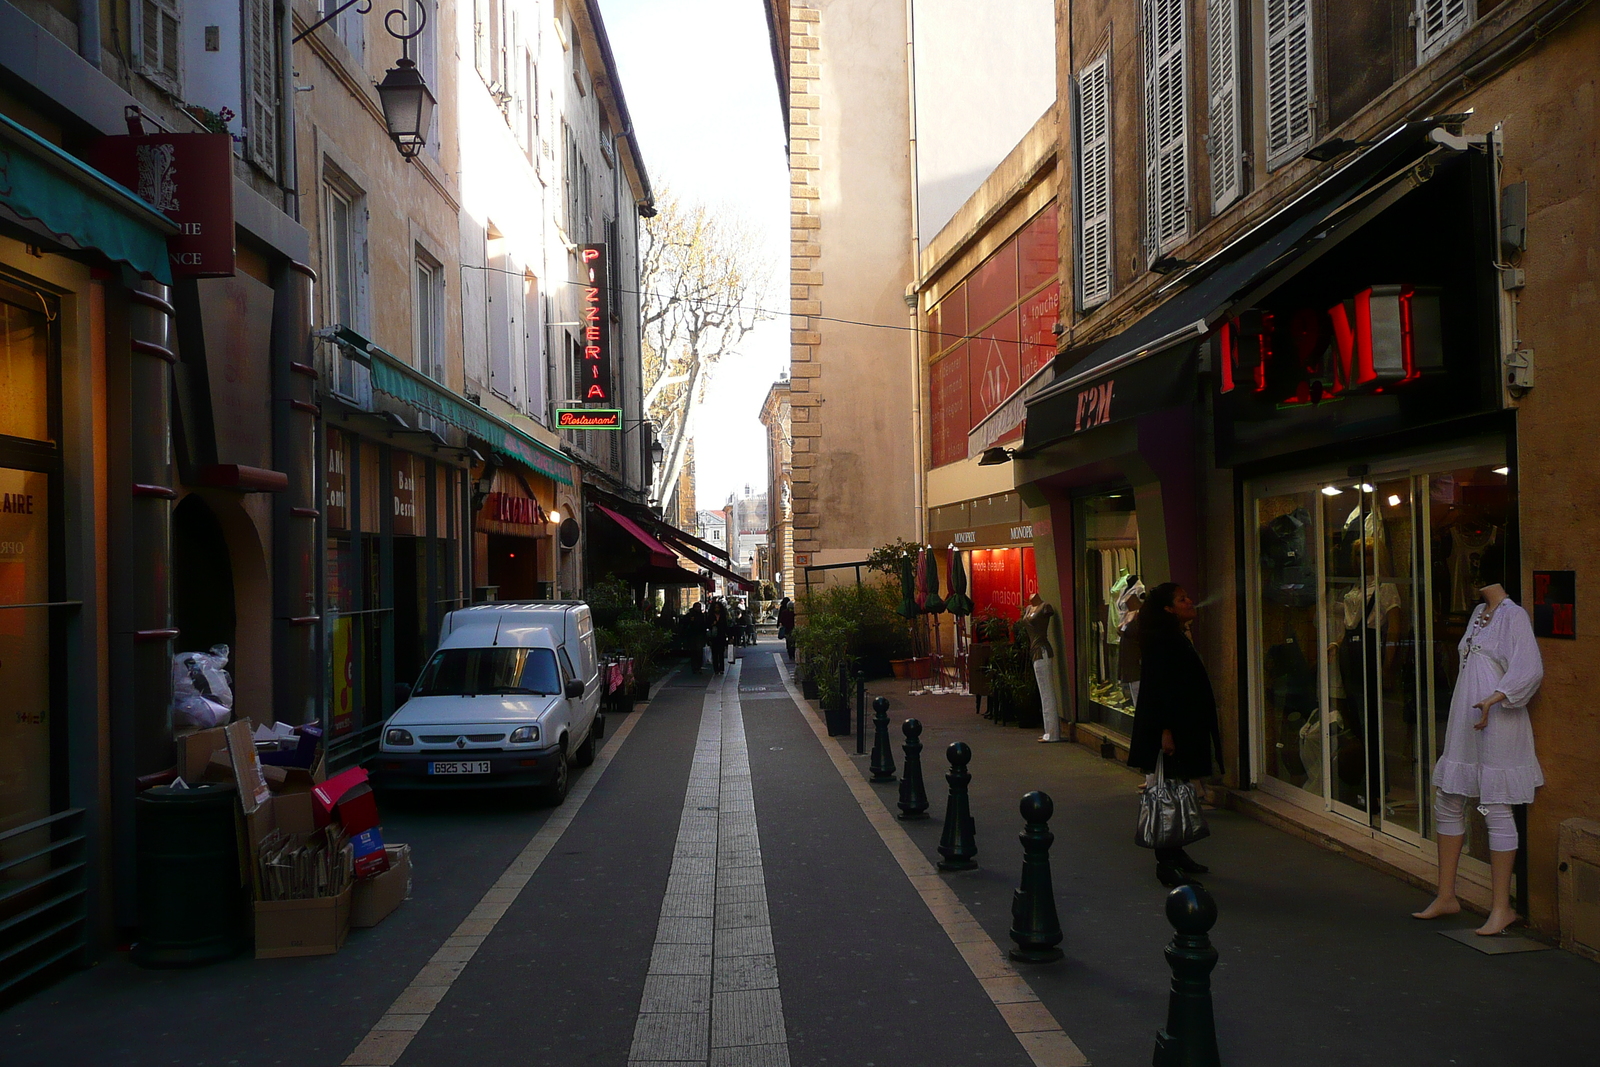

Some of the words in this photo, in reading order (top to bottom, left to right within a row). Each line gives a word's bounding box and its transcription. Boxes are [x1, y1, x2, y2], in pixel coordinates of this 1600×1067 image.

[582, 249, 606, 399] PIZZERIA
[560, 412, 617, 426] Restaurant
[0, 492, 34, 514] AIRE
[435, 763, 458, 774] 6925
[461, 762, 474, 773] SJ
[478, 762, 489, 773] 13
